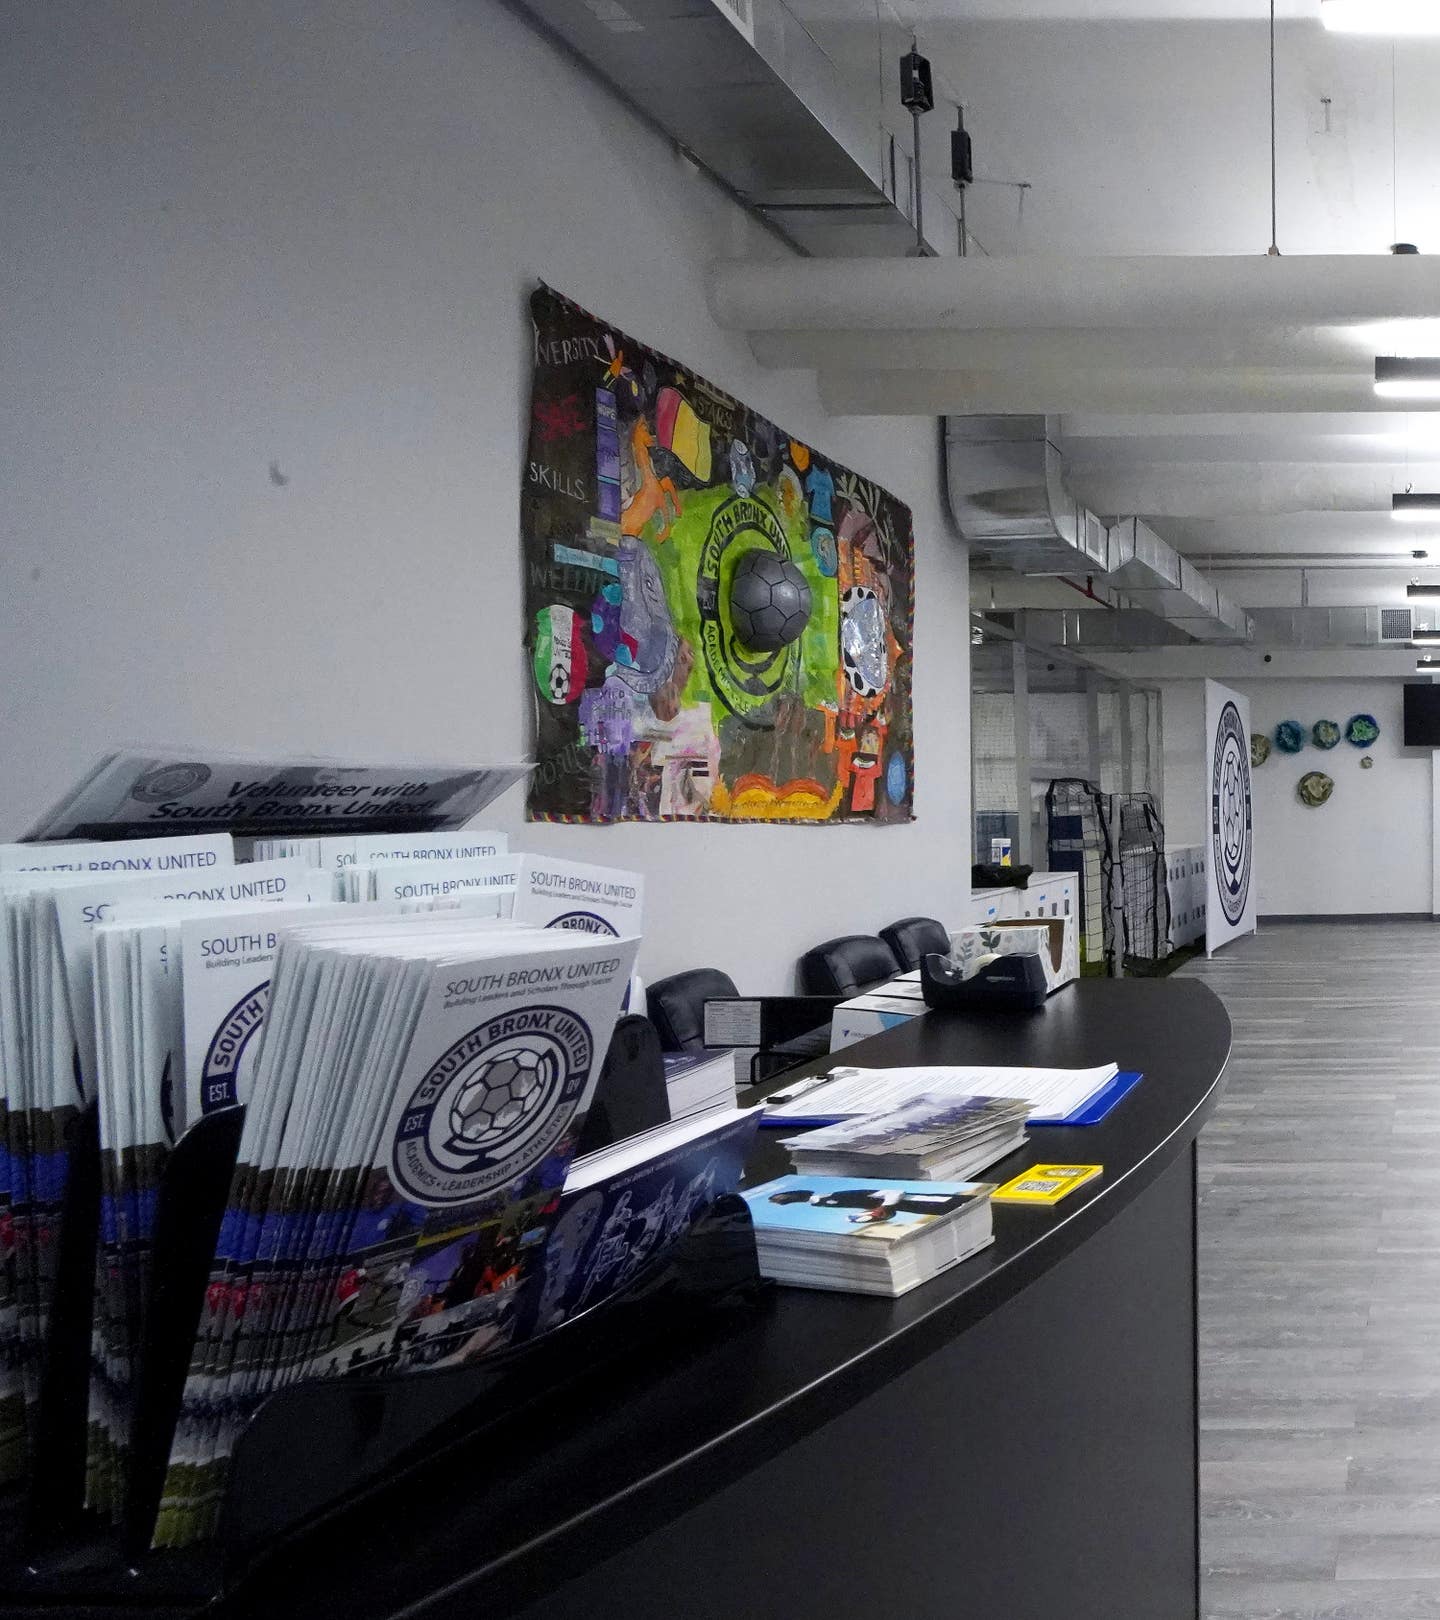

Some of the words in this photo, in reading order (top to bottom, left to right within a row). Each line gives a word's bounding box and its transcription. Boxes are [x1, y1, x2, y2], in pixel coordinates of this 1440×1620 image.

[530, 462, 585, 500] SKILLS
[227, 780, 371, 798] Volunteer
[370, 781, 430, 797] with
[149, 801, 249, 820] South
[250, 800, 341, 817] Bronx
[157, 851, 217, 871] UNITED
[230, 877, 287, 900] UNITED
[394, 882, 440, 900] SOUTH
[530, 871, 567, 888] SOUTH
[568, 877, 603, 894] BRONX
[603, 884, 637, 900] UNITED
[201, 934, 261, 957] SOUTH
[444, 973, 504, 998] SOUTH
[506, 965, 565, 988] BRONX
[567, 958, 621, 979] UNITED
[214, 999, 264, 1067] SOUTH
[420, 1037, 483, 1100] SOUTH
[487, 1012, 556, 1041] BRONX
[554, 1017, 589, 1069] UNITED
[209, 1082, 231, 1102] EST.
[406, 1140, 438, 1187] ACADEMICS
[441, 1162, 512, 1191] LEADERSHIP
